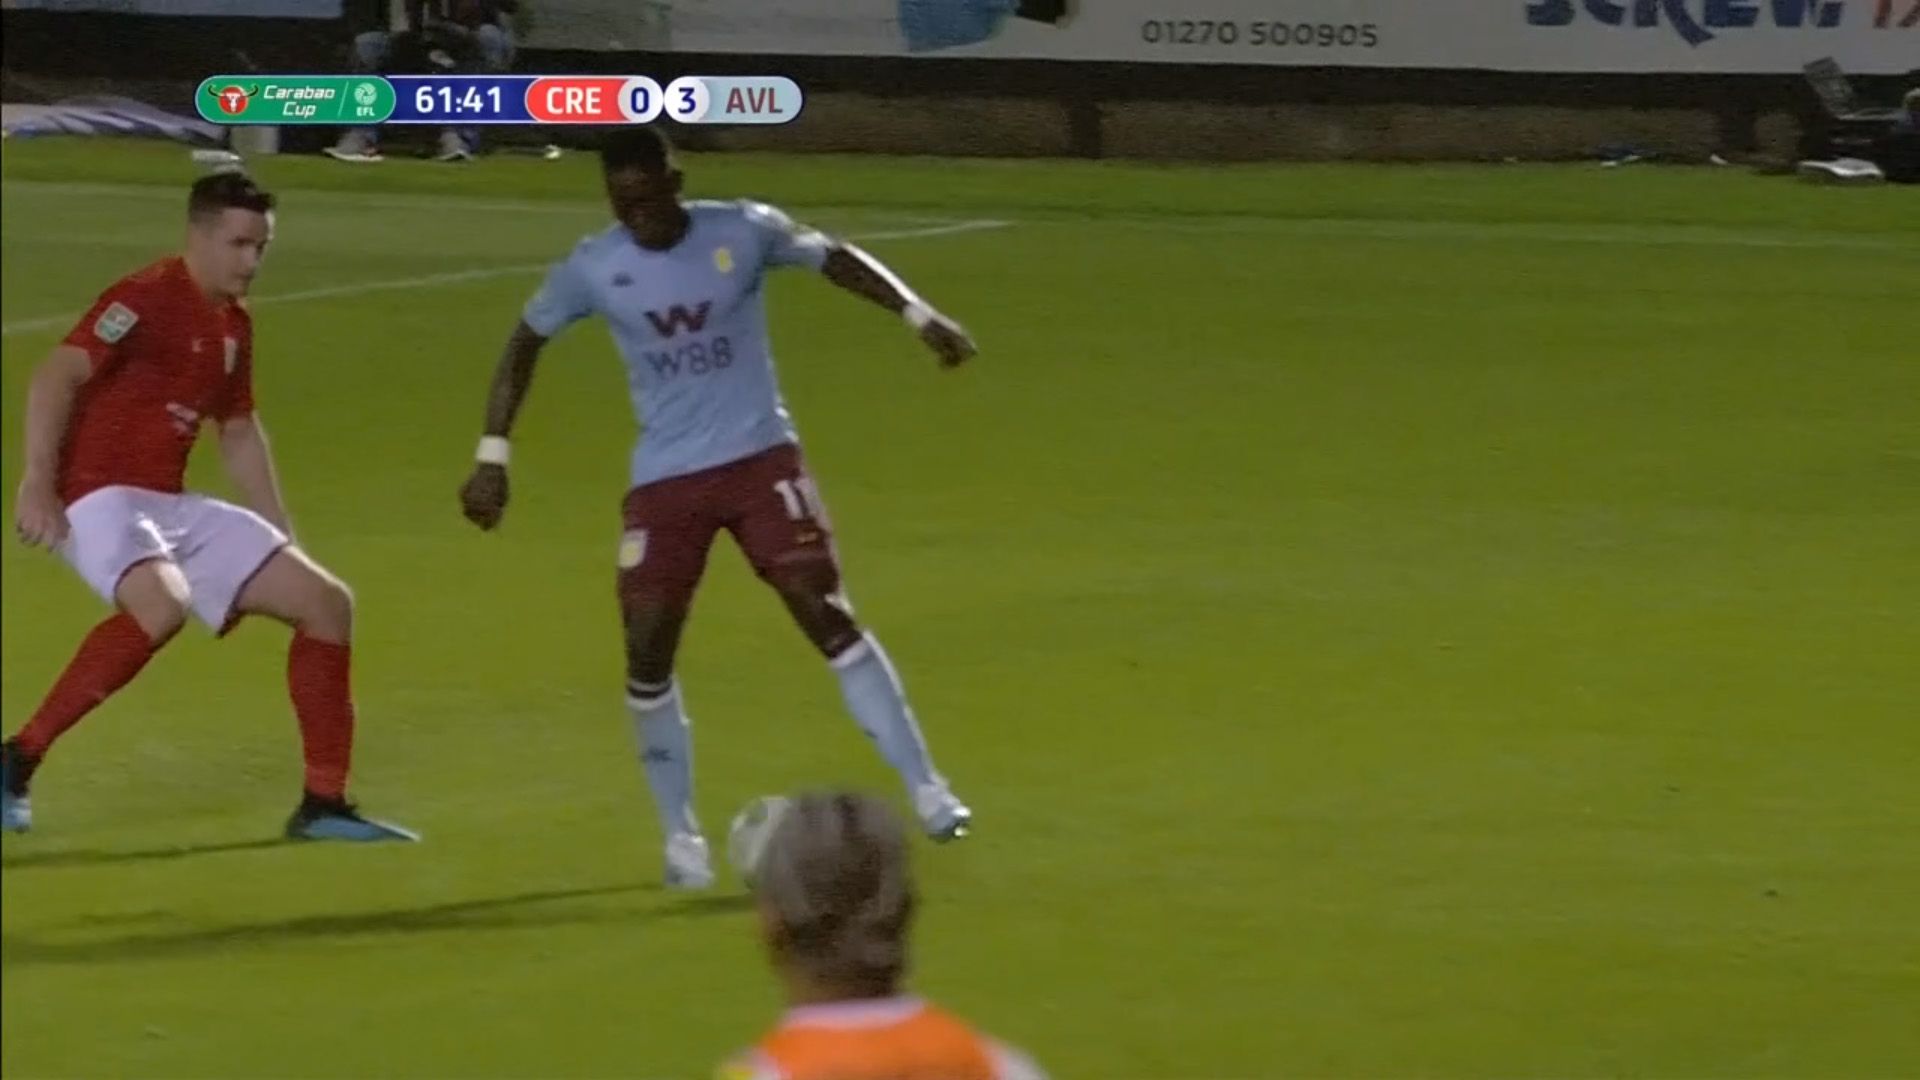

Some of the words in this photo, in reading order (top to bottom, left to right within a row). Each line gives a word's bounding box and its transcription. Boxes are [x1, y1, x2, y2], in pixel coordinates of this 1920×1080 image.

[1141, 20, 1239, 45] 01270
[1250, 22, 1379, 48] 500905
[644, 336, 734, 376] W88
